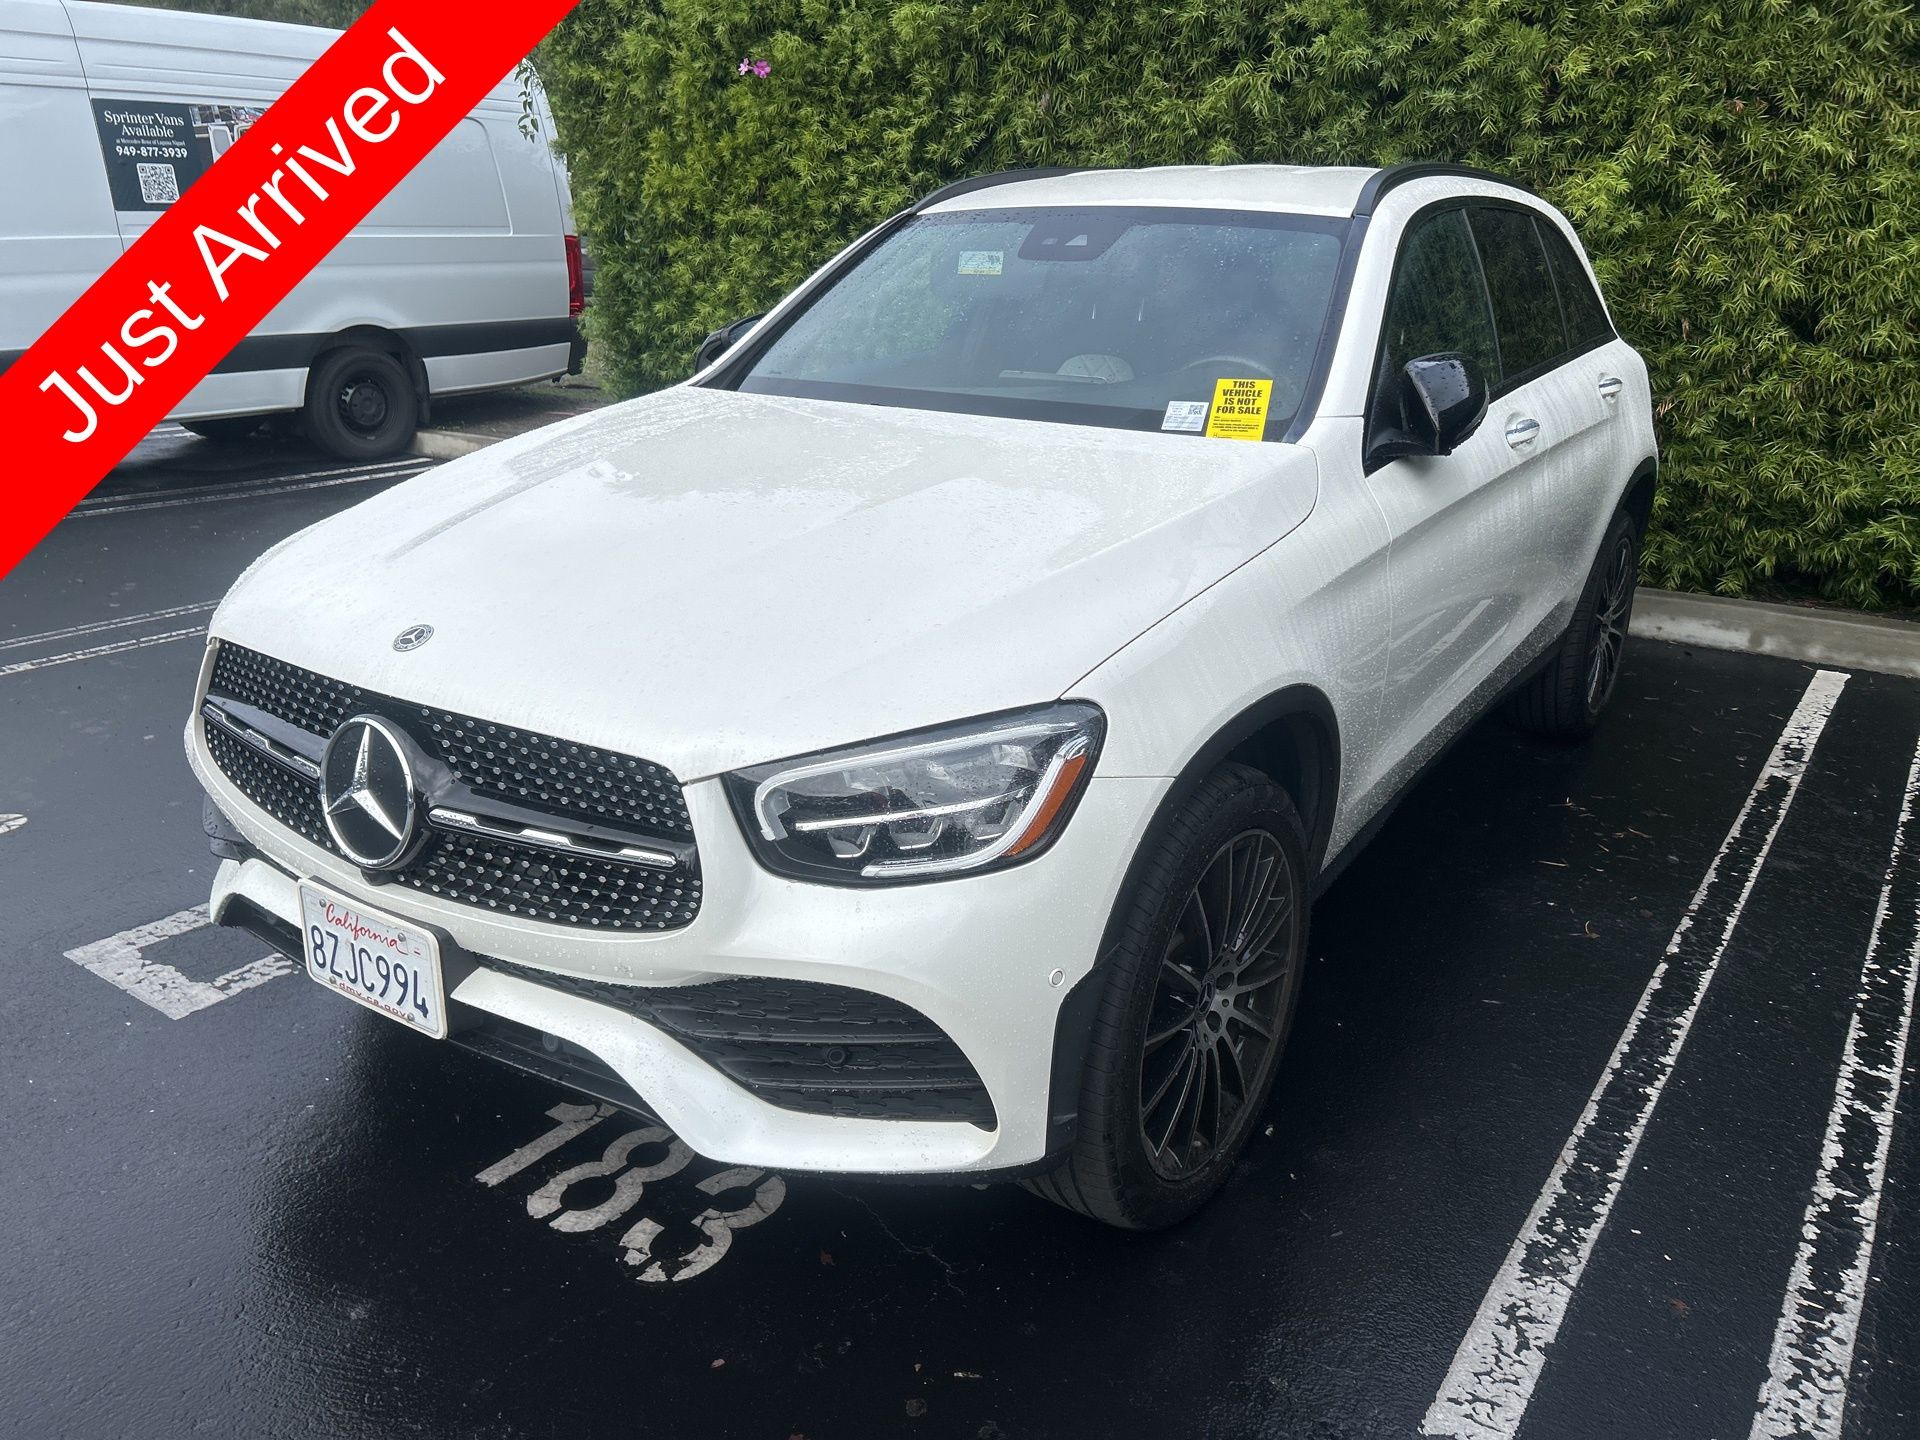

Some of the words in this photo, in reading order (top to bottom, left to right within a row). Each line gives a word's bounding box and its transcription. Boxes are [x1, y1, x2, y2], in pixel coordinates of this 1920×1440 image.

[104, 110, 153, 125] Sprinter
[154, 113, 185, 126] Vans
[121, 125, 174, 138] Available
[115, 146, 188, 158] 949-877-3939
[1233, 380, 1256, 389] THIS
[1222, 389, 1263, 398] VEHICLE
[1236, 398, 1258, 406] NOT
[1216, 406, 1236, 414] FOR
[1239, 406, 1262, 415] SALE
[325, 903, 408, 956] California
[311, 925, 429, 1019] 8ZJC994
[338, 981, 408, 1020] dmv.ca.gov
[475, 1102, 787, 1282] 183
